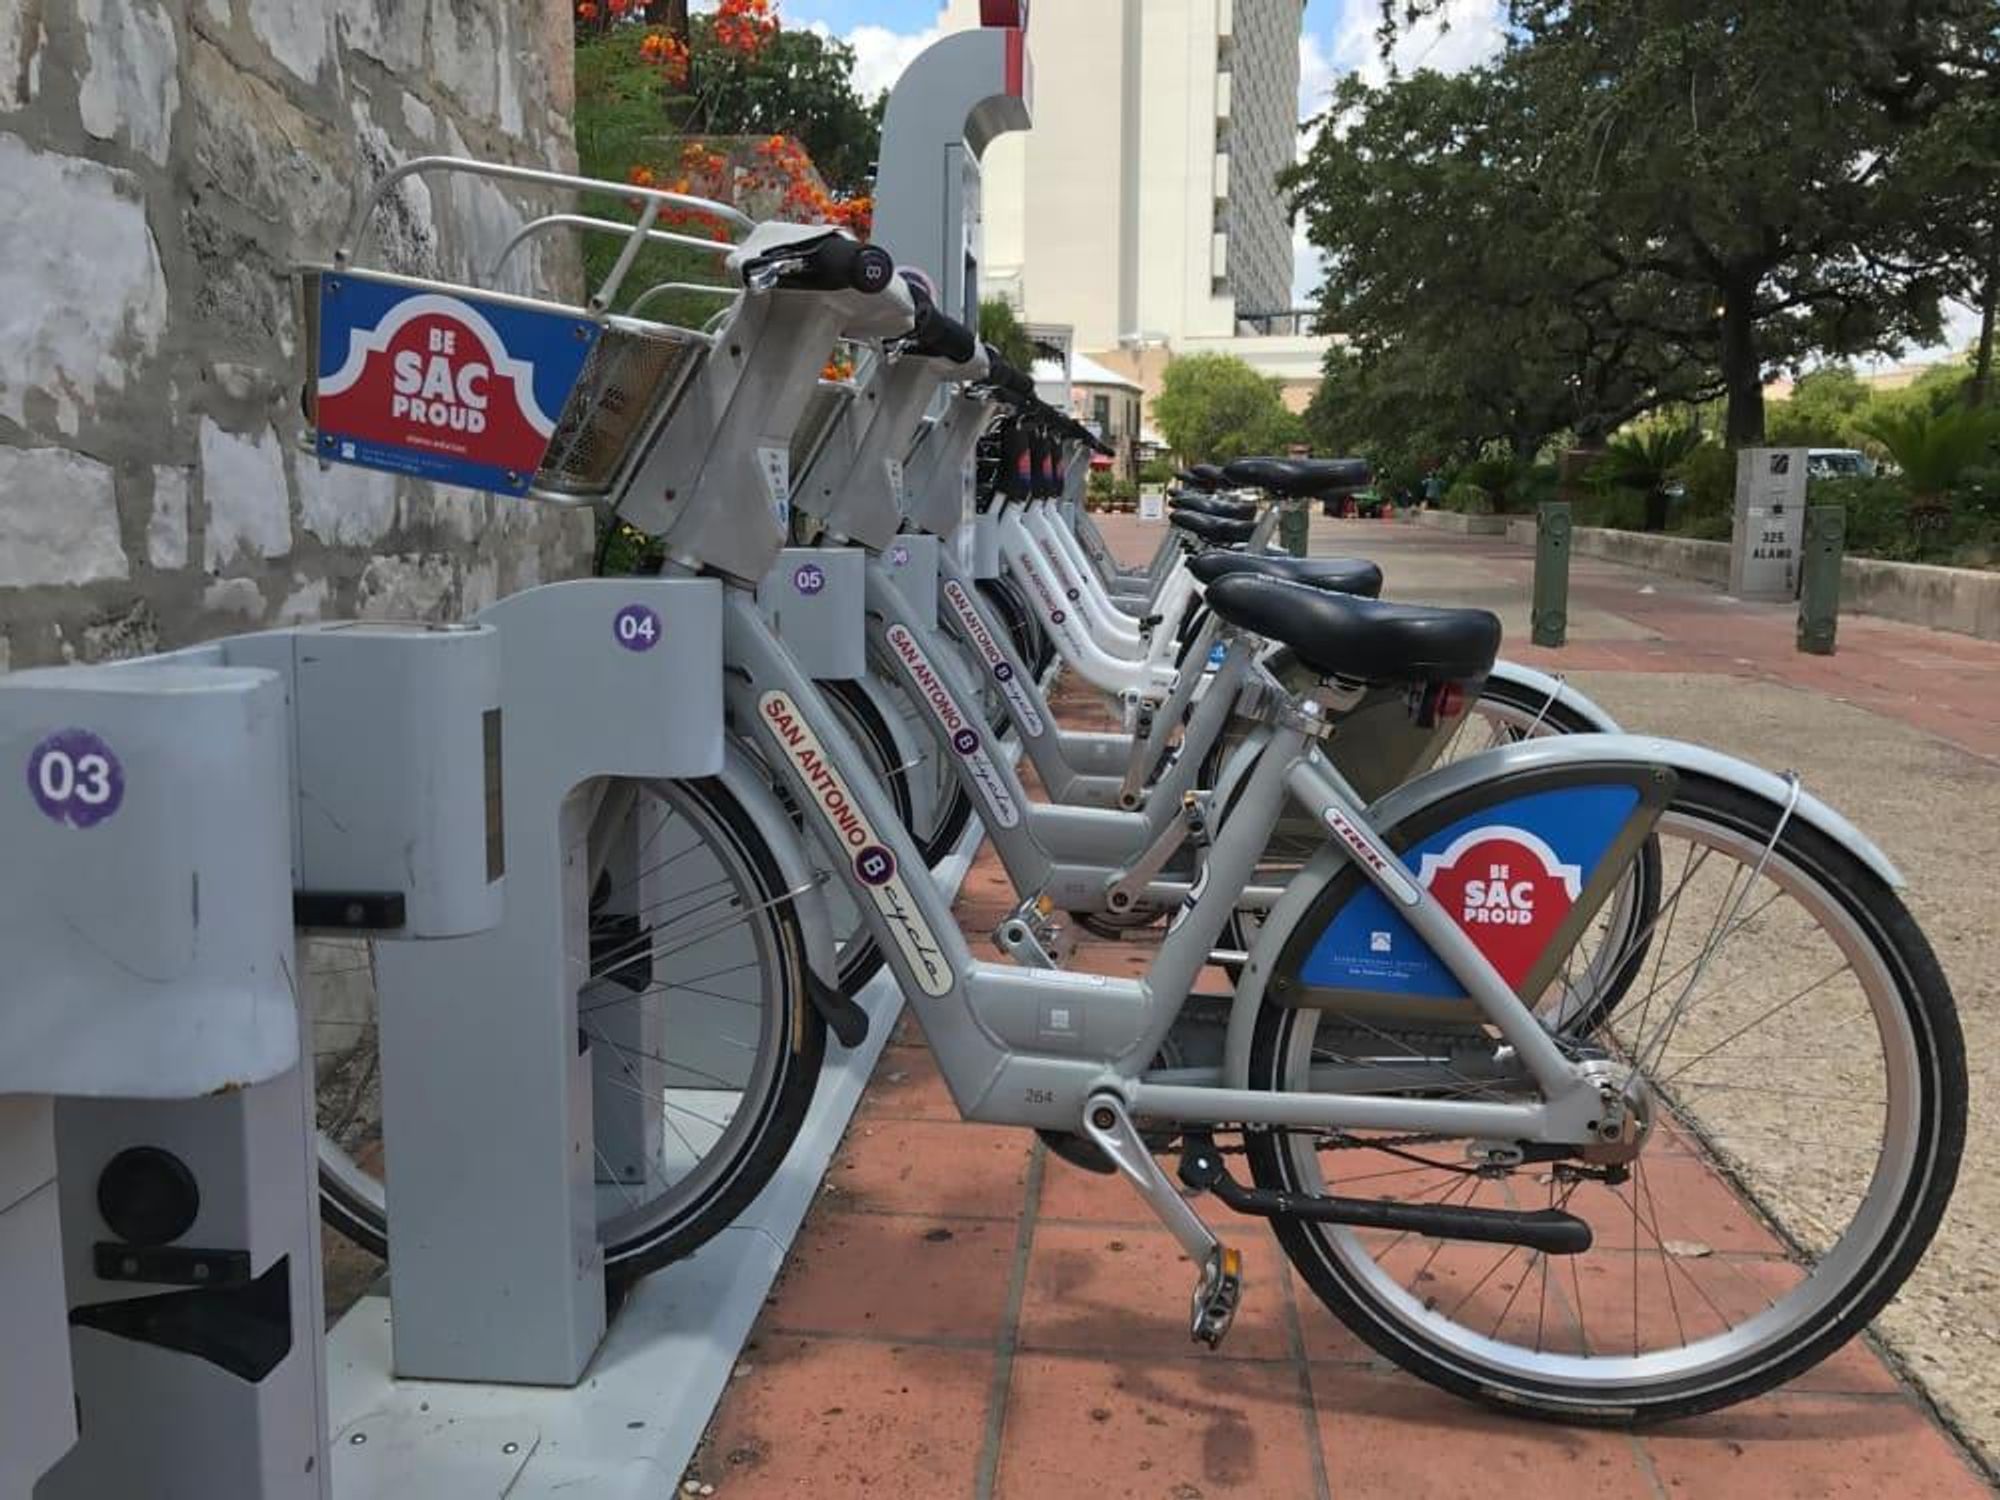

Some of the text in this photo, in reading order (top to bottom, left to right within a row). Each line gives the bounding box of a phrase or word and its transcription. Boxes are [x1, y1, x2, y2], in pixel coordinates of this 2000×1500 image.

[429, 327, 456, 355] BE
[394, 350, 489, 409] SAC
[393, 394, 486, 433] PROUD
[1761, 531, 1785, 544] 325
[797, 572, 821, 588] 05
[620, 614, 656, 640] 04
[948, 584, 967, 612] SAN
[963, 611, 1001, 664] ANTONIO
[890, 629, 919, 664] SAN
[912, 663, 962, 730] ANTONIO
[40, 750, 111, 804] 03
[765, 698, 805, 747] SAN
[796, 747, 867, 848] ANTONIO
[863, 854, 886, 877] B
[1331, 814, 1387, 871] TREK
[1490, 864, 1510, 880] BE
[1465, 880, 1534, 910] SAC
[1464, 907, 1532, 924] PROUD
[1024, 1088, 1054, 1104] 264
